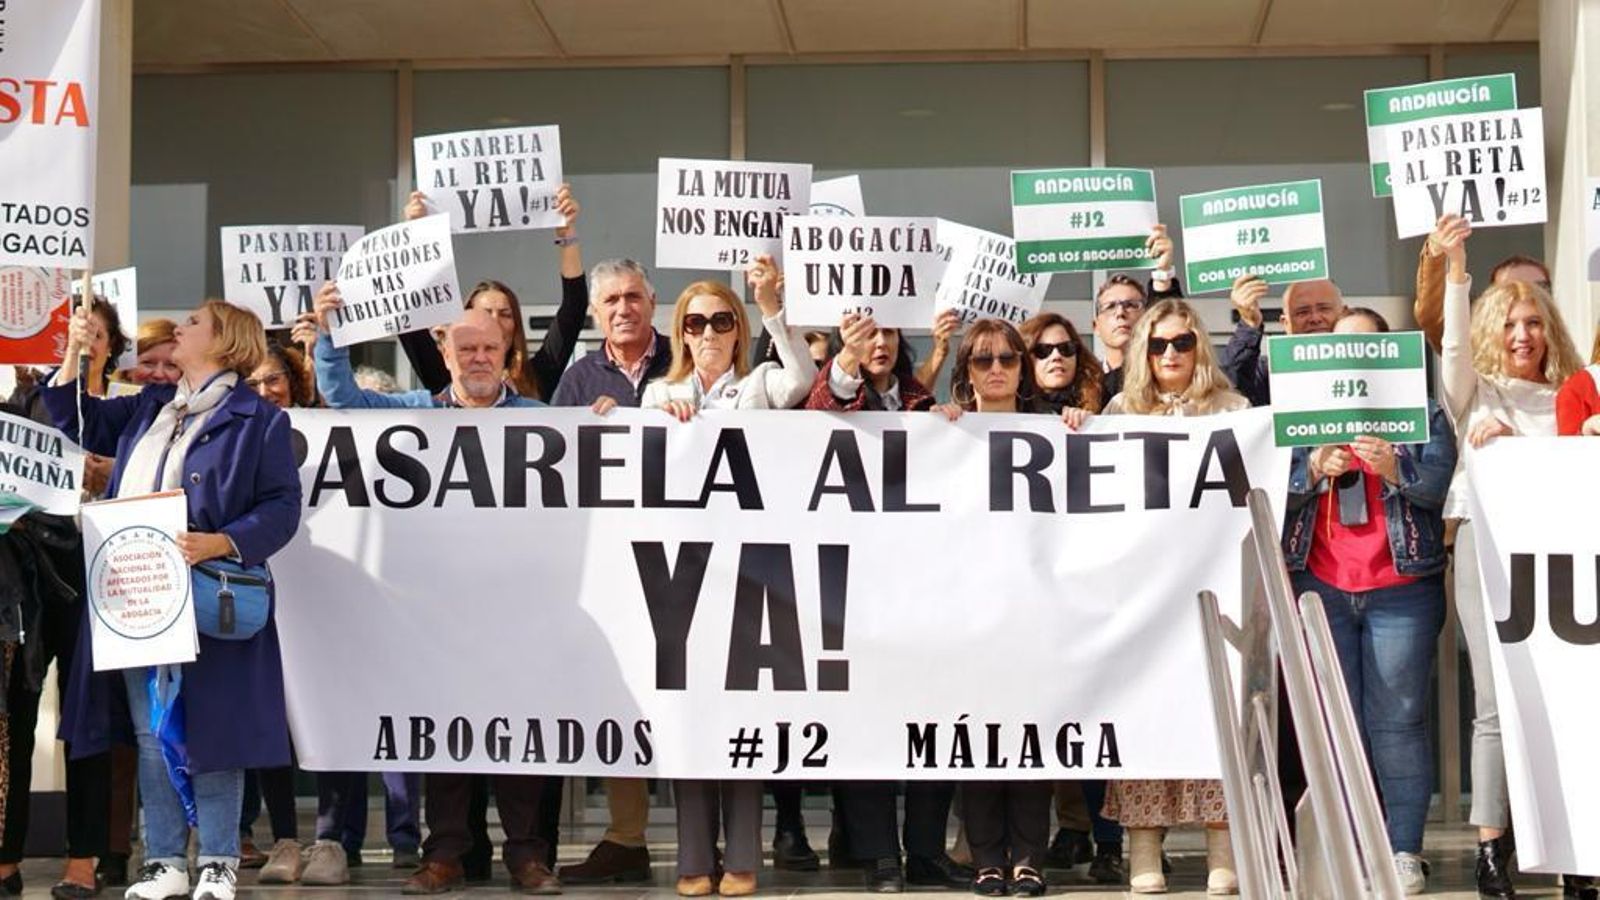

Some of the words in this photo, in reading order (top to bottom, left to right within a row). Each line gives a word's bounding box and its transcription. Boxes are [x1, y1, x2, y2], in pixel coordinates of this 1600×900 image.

[1389, 83, 1491, 113] ANDALUCÍA
[431, 133, 543, 160] PASARELA
[1401, 117, 1523, 152] PASARELA
[434, 168, 459, 188] AL
[475, 157, 545, 185] RETA
[1406, 160, 1429, 184] AL
[1445, 145, 1524, 177] RETA
[678, 169, 704, 196] LA
[714, 171, 791, 200] MUTUA
[1035, 174, 1134, 194] ANDALUCÍA
[457, 186, 530, 229] YA!
[1203, 189, 1299, 216] ANDALUCÍA
[1427, 177, 1506, 226] YA!
[1507, 187, 1541, 206] #J2
[1, 203, 90, 228] TADOS
[662, 208, 705, 235] NOS
[1070, 210, 1105, 228] #J2
[239, 232, 348, 253] PASARELA
[362, 227, 410, 256] MENOS
[790, 223, 932, 252] ABOGACÍA
[1237, 226, 1270, 245] #J2
[240, 263, 266, 283] AL
[283, 256, 343, 281] RET
[718, 249, 749, 265] #J2
[1028, 253, 1056, 264] CON
[1059, 251, 1079, 262] LOS
[373, 272, 405, 295] MAS
[804, 263, 917, 297] UNIDA
[1199, 269, 1225, 283] CON
[1249, 260, 1315, 277] ABOGADOS
[336, 283, 453, 328] JUBILACIONES
[384, 314, 411, 332] #J2
[1293, 338, 1399, 361] ANDALUCÍA
[1332, 379, 1368, 397] #J2
[1286, 424, 1317, 436] CON
[1320, 422, 1342, 434] LOS
[1346, 421, 1415, 433] ABOGADOS
[807, 429, 941, 512] AL
[989, 428, 1251, 514] RETA
[631, 541, 849, 692] YA!
[374, 716, 654, 766] ABOGADOS
[729, 722, 829, 775] #J2
[906, 714, 1122, 769] MÁLAGA
